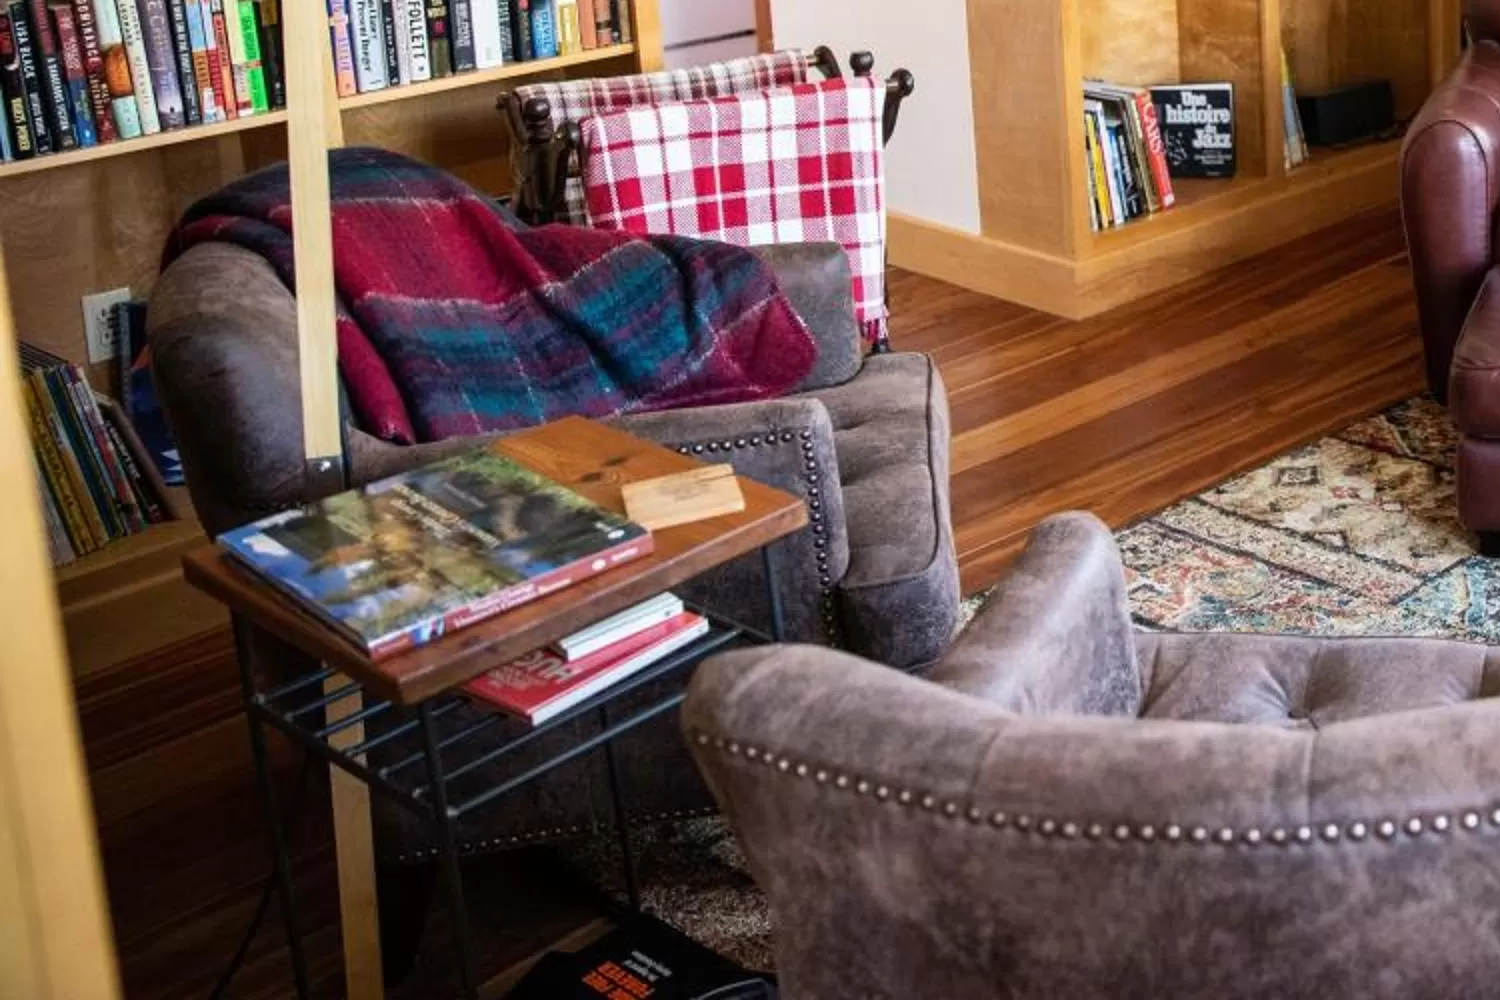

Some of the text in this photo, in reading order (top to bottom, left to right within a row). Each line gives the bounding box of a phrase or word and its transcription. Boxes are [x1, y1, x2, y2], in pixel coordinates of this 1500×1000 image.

[404, 0, 430, 60] FOLLETT
[19, 46, 36, 79] BLACK
[1165, 103, 1231, 125] histoire
[1192, 128, 1232, 149] Jazz
